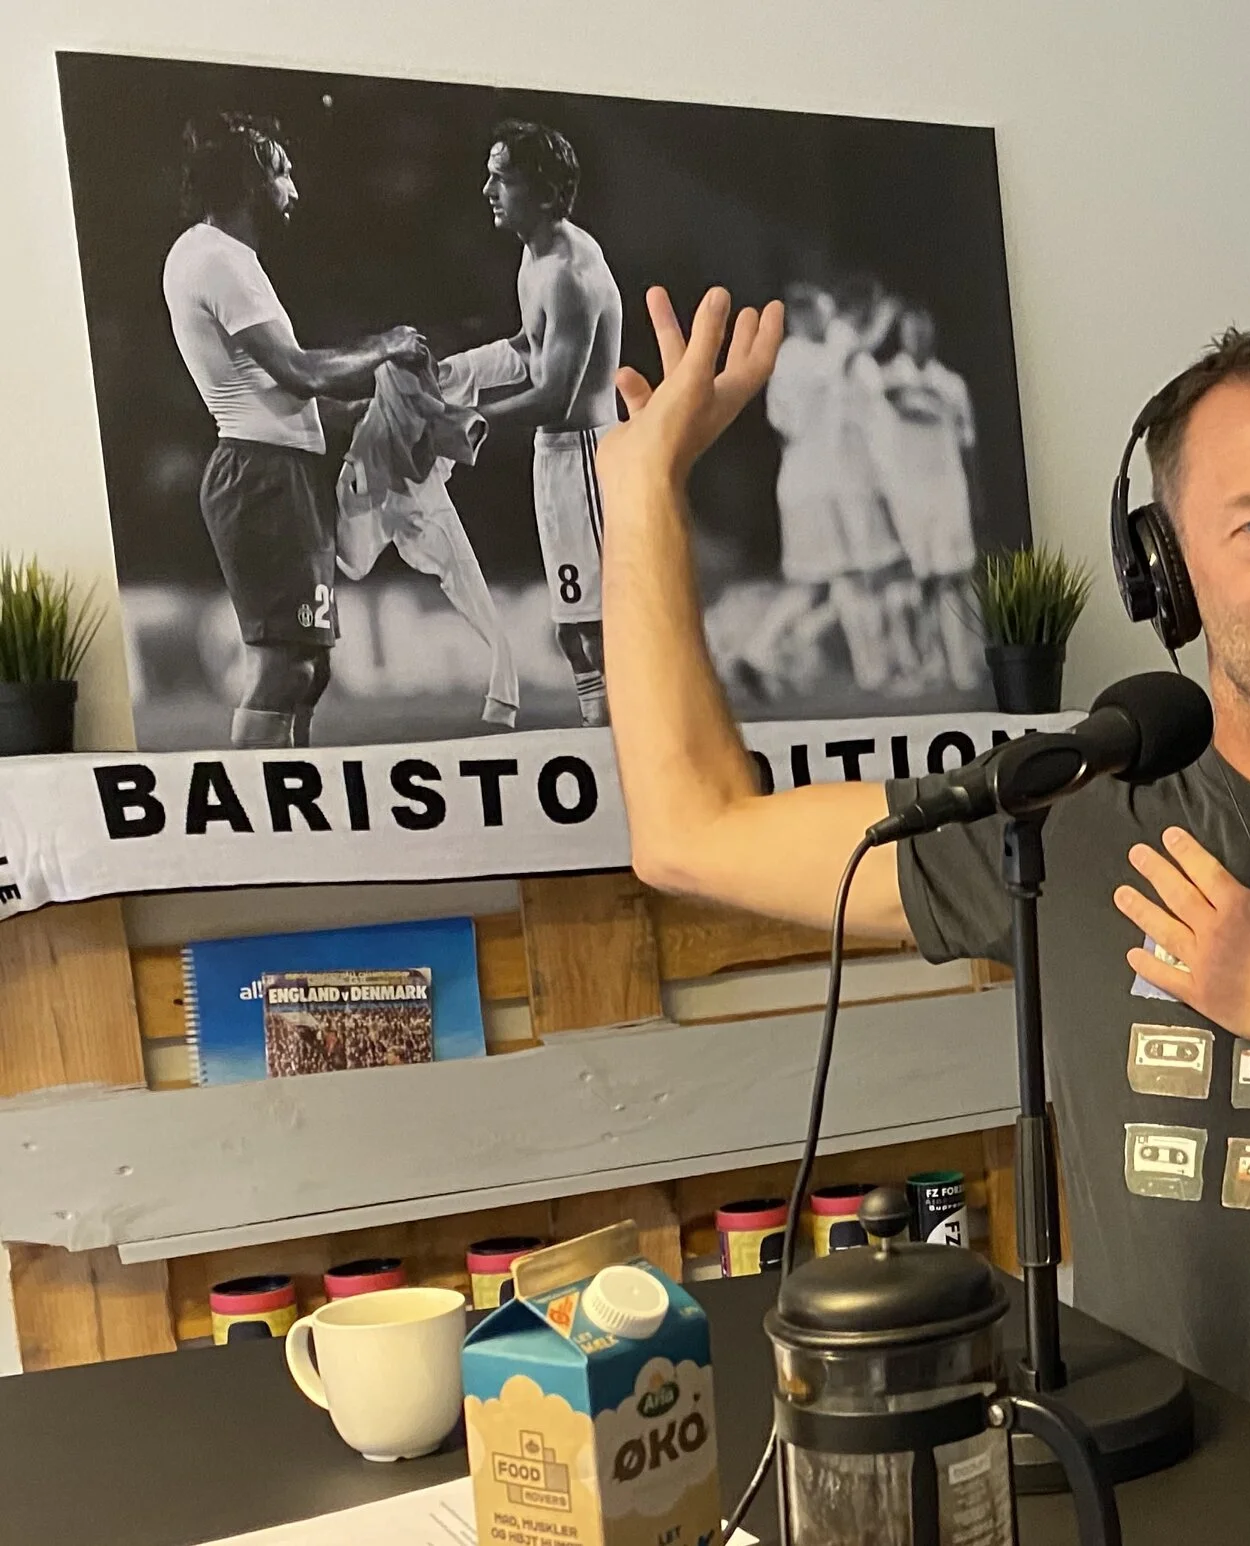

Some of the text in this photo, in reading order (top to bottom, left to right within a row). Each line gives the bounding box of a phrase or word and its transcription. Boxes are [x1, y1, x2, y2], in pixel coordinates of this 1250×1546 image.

[557, 563, 582, 604] 8
[93, 754, 598, 841] BARISTO
[268, 985, 427, 1004] ENGLAND v DENMARK
[926, 1188, 939, 1198] FZ
[612, 1411, 708, 1483] ØKO
[498, 1460, 540, 1481] FOOD
[491, 1527, 506, 1540] OG
